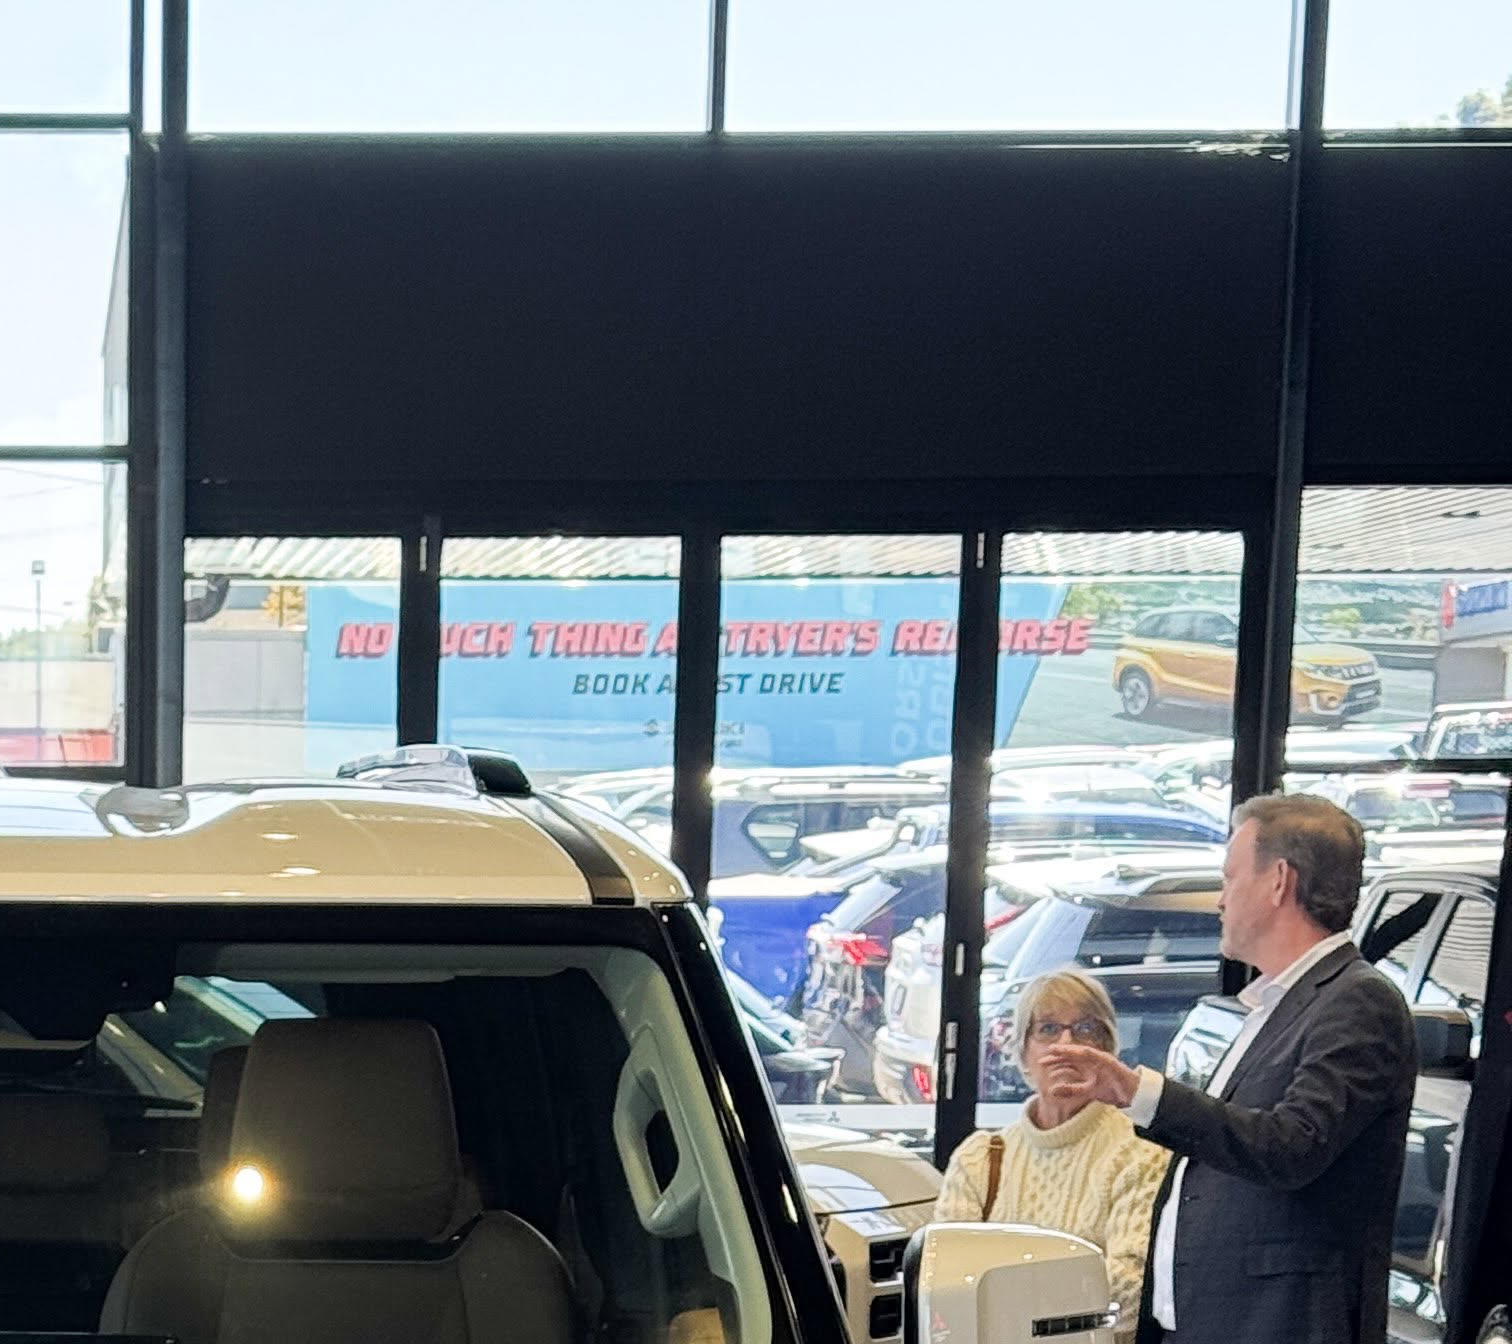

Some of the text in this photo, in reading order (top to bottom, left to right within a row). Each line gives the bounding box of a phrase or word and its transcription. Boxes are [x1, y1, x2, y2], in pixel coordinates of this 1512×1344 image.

[337, 623, 393, 657] NO
[440, 622, 515, 657] UCH
[527, 621, 649, 658] THING
[722, 620, 881, 657] TRYER'S
[892, 619, 1095, 656] RERSE
[572, 673, 651, 695] BOOK
[759, 672, 845, 695] DRIVE
